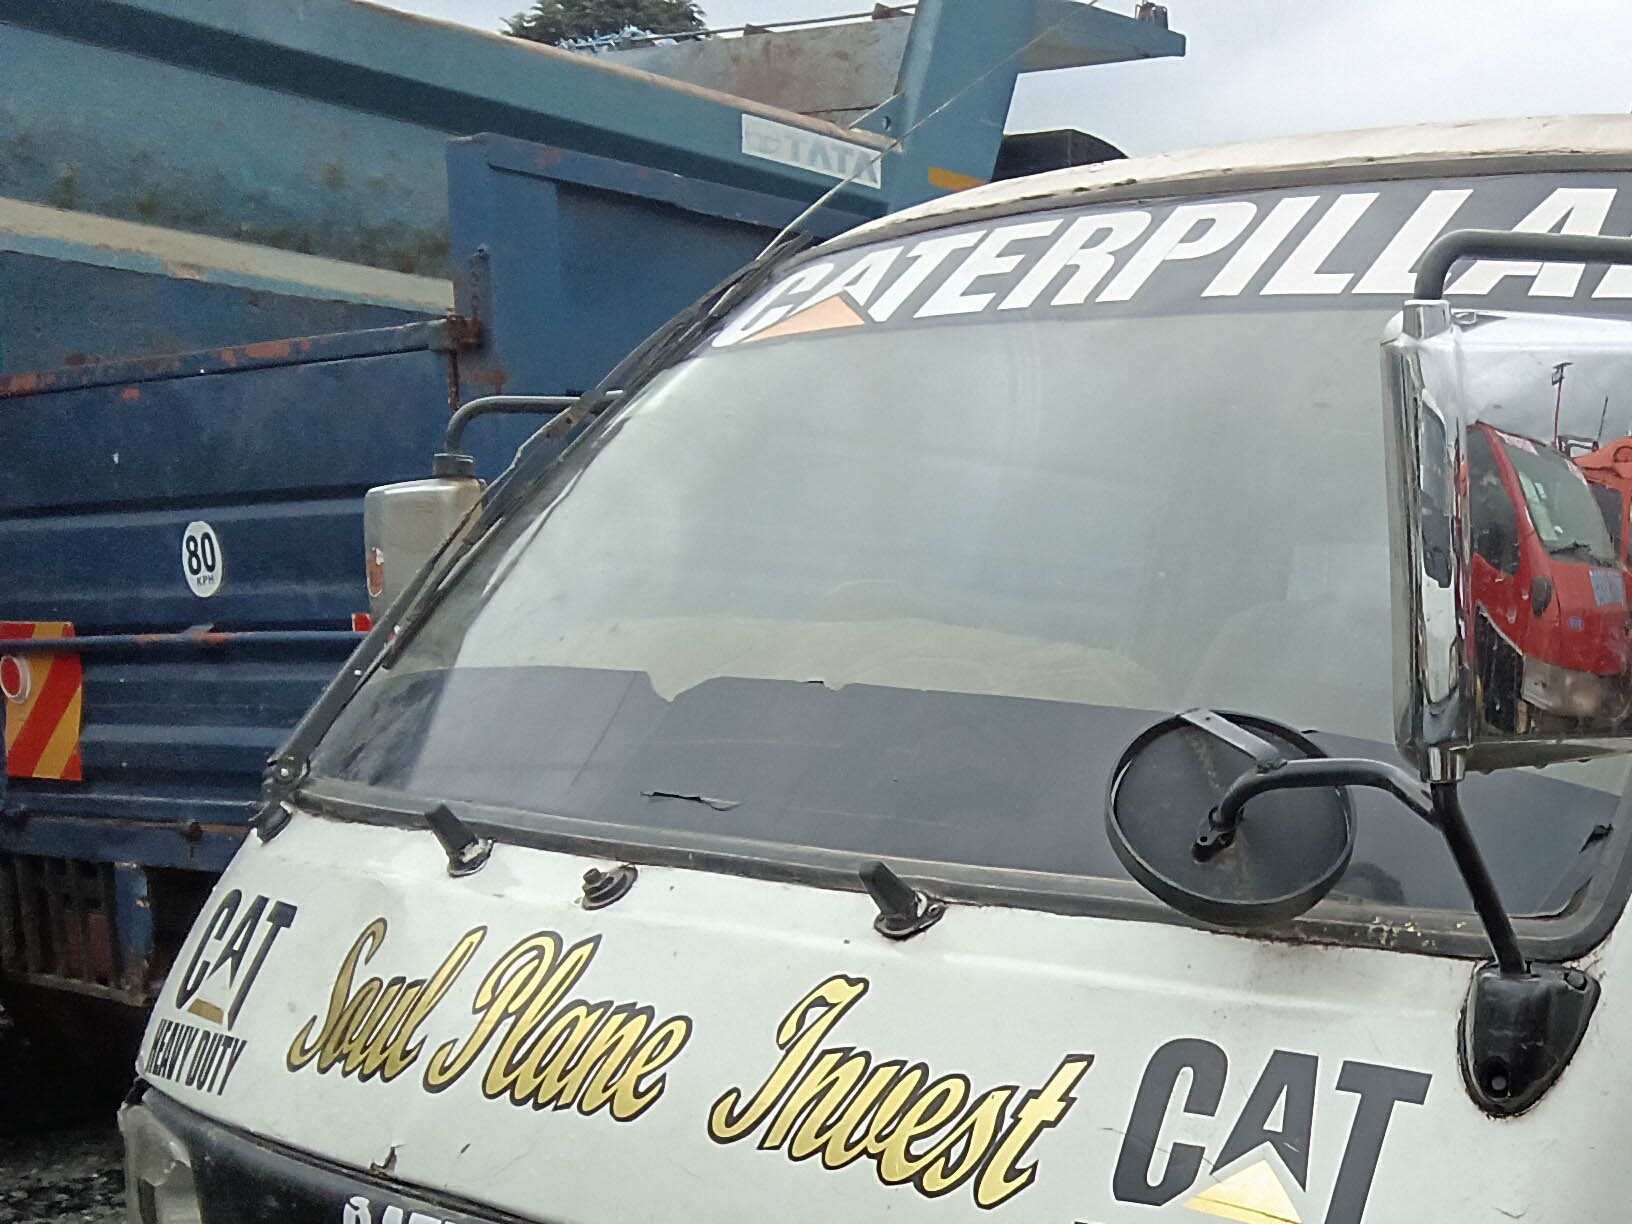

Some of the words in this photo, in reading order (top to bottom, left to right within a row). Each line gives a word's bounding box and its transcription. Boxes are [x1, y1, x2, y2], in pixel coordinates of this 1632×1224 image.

[185, 532, 216, 576] 80
[196, 575, 215, 586] KPH
[175, 888, 297, 1031] CAT
[145, 1018, 201, 1084] HEAVY
[184, 1030, 248, 1096] DUTY
[287, 917, 487, 1083] Soul
[423, 930, 693, 1123] Plane
[708, 975, 1093, 1210] Invest
